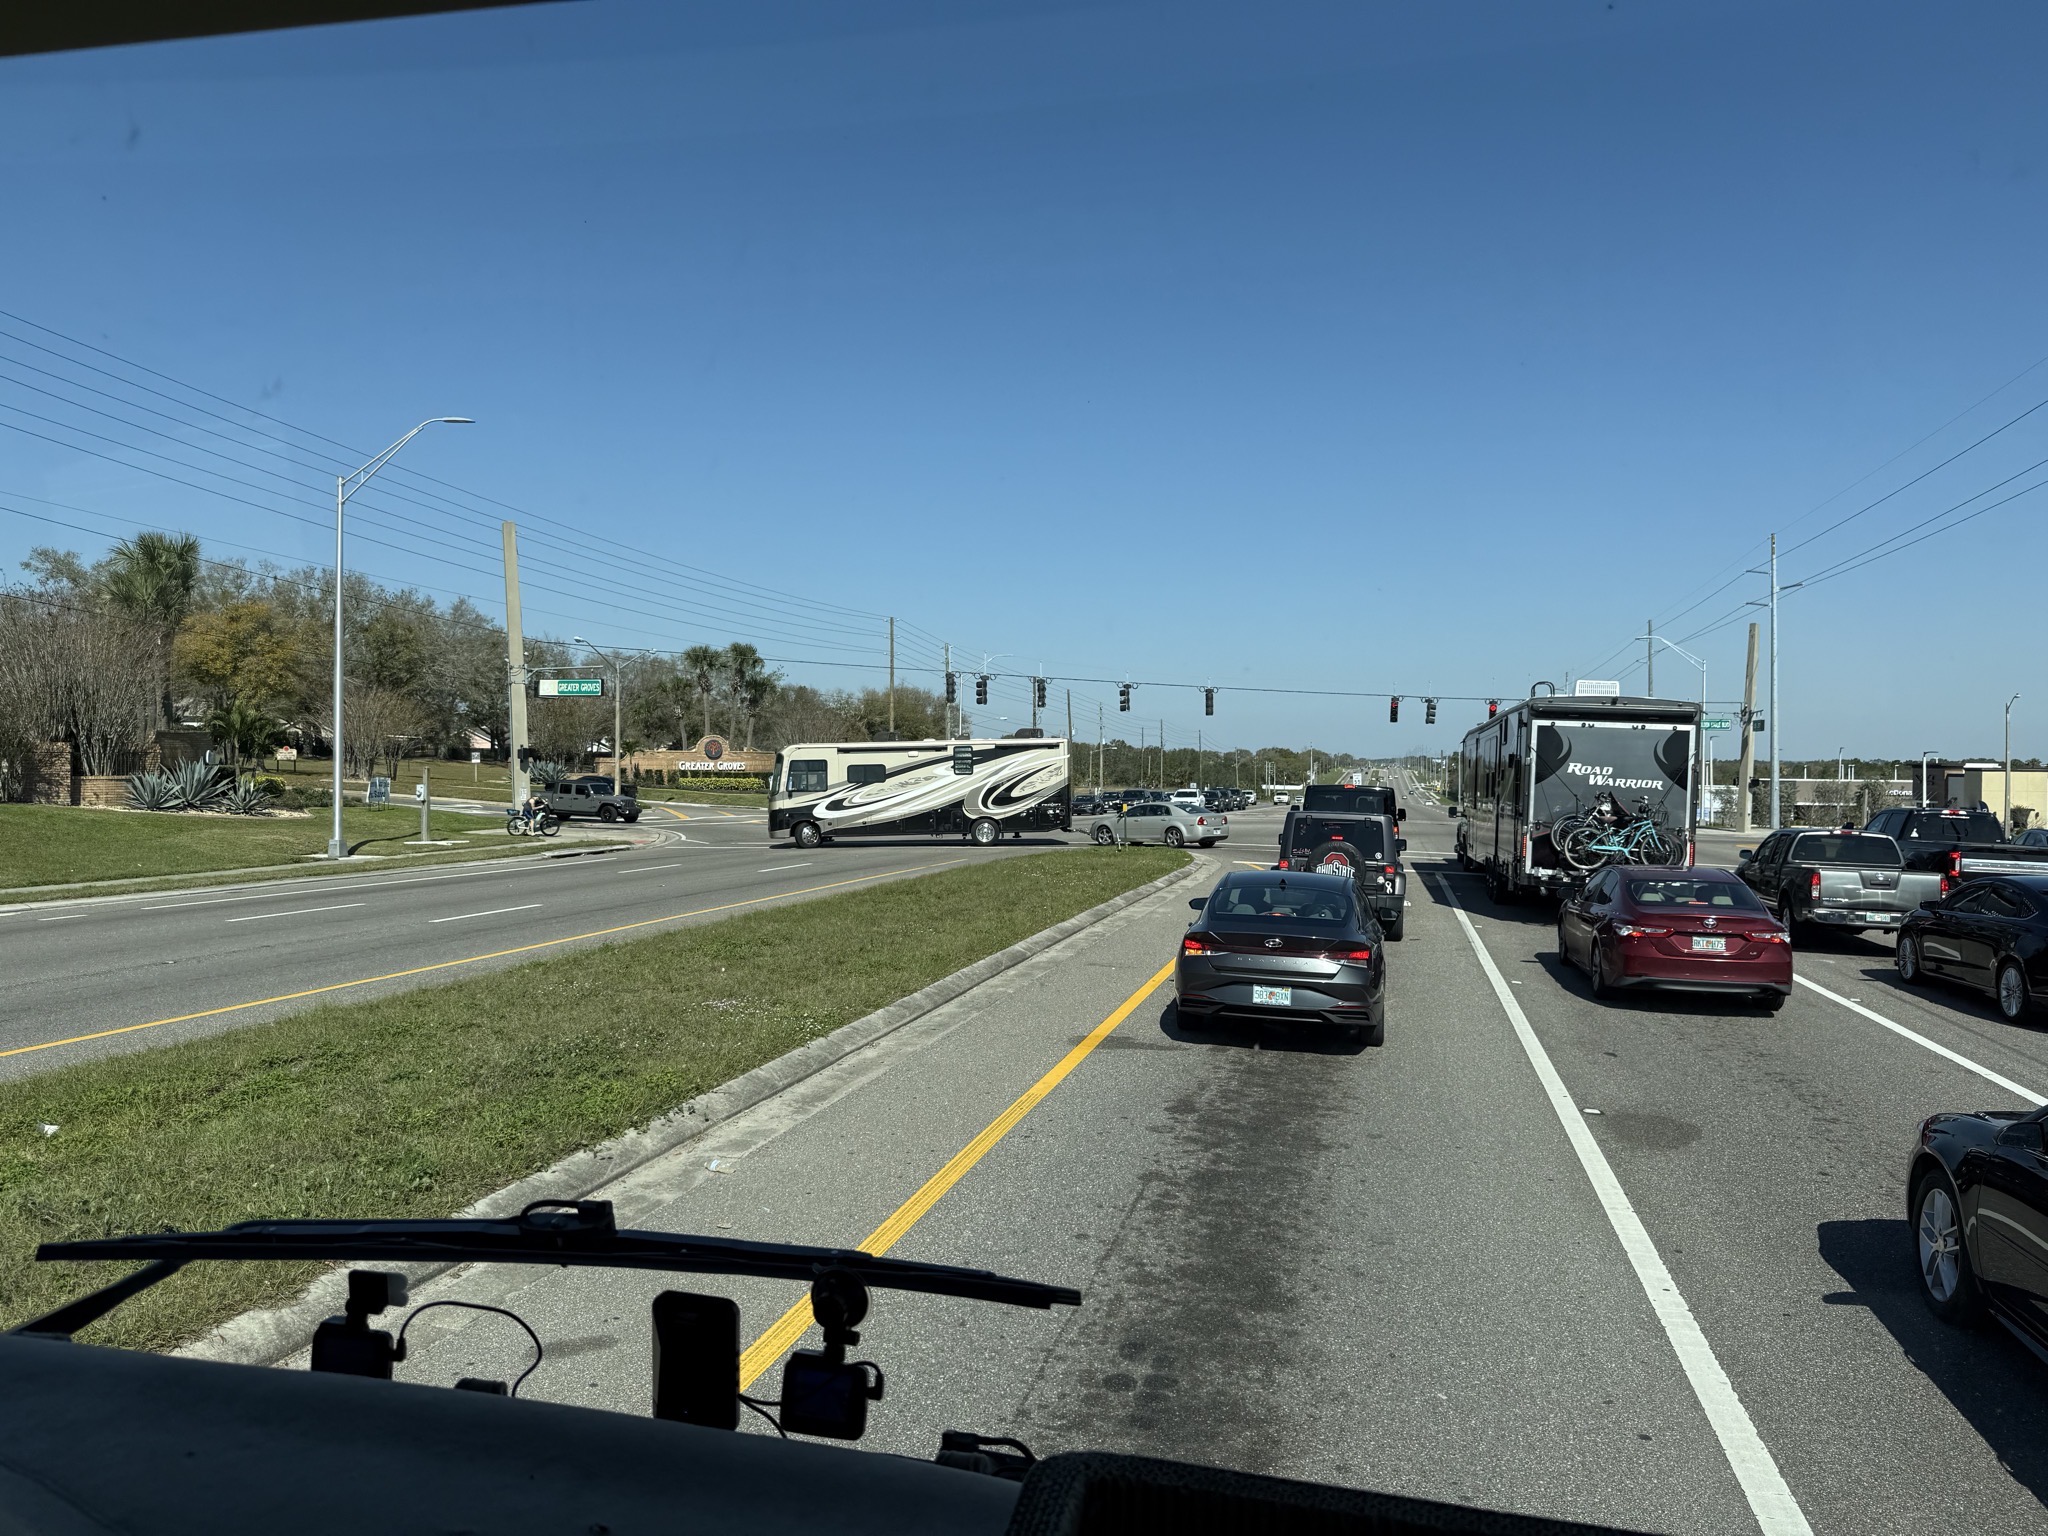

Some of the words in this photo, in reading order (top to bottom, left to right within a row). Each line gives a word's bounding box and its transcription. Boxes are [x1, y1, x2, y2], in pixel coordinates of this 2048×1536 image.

[558, 683, 579, 692] GREATER
[581, 683, 600, 692] GROVES
[679, 761, 714, 771] GREATER
[717, 761, 746, 771] GROVES
[1567, 762, 1613, 776] ROAD
[1589, 775, 1664, 790] WARRIOR
